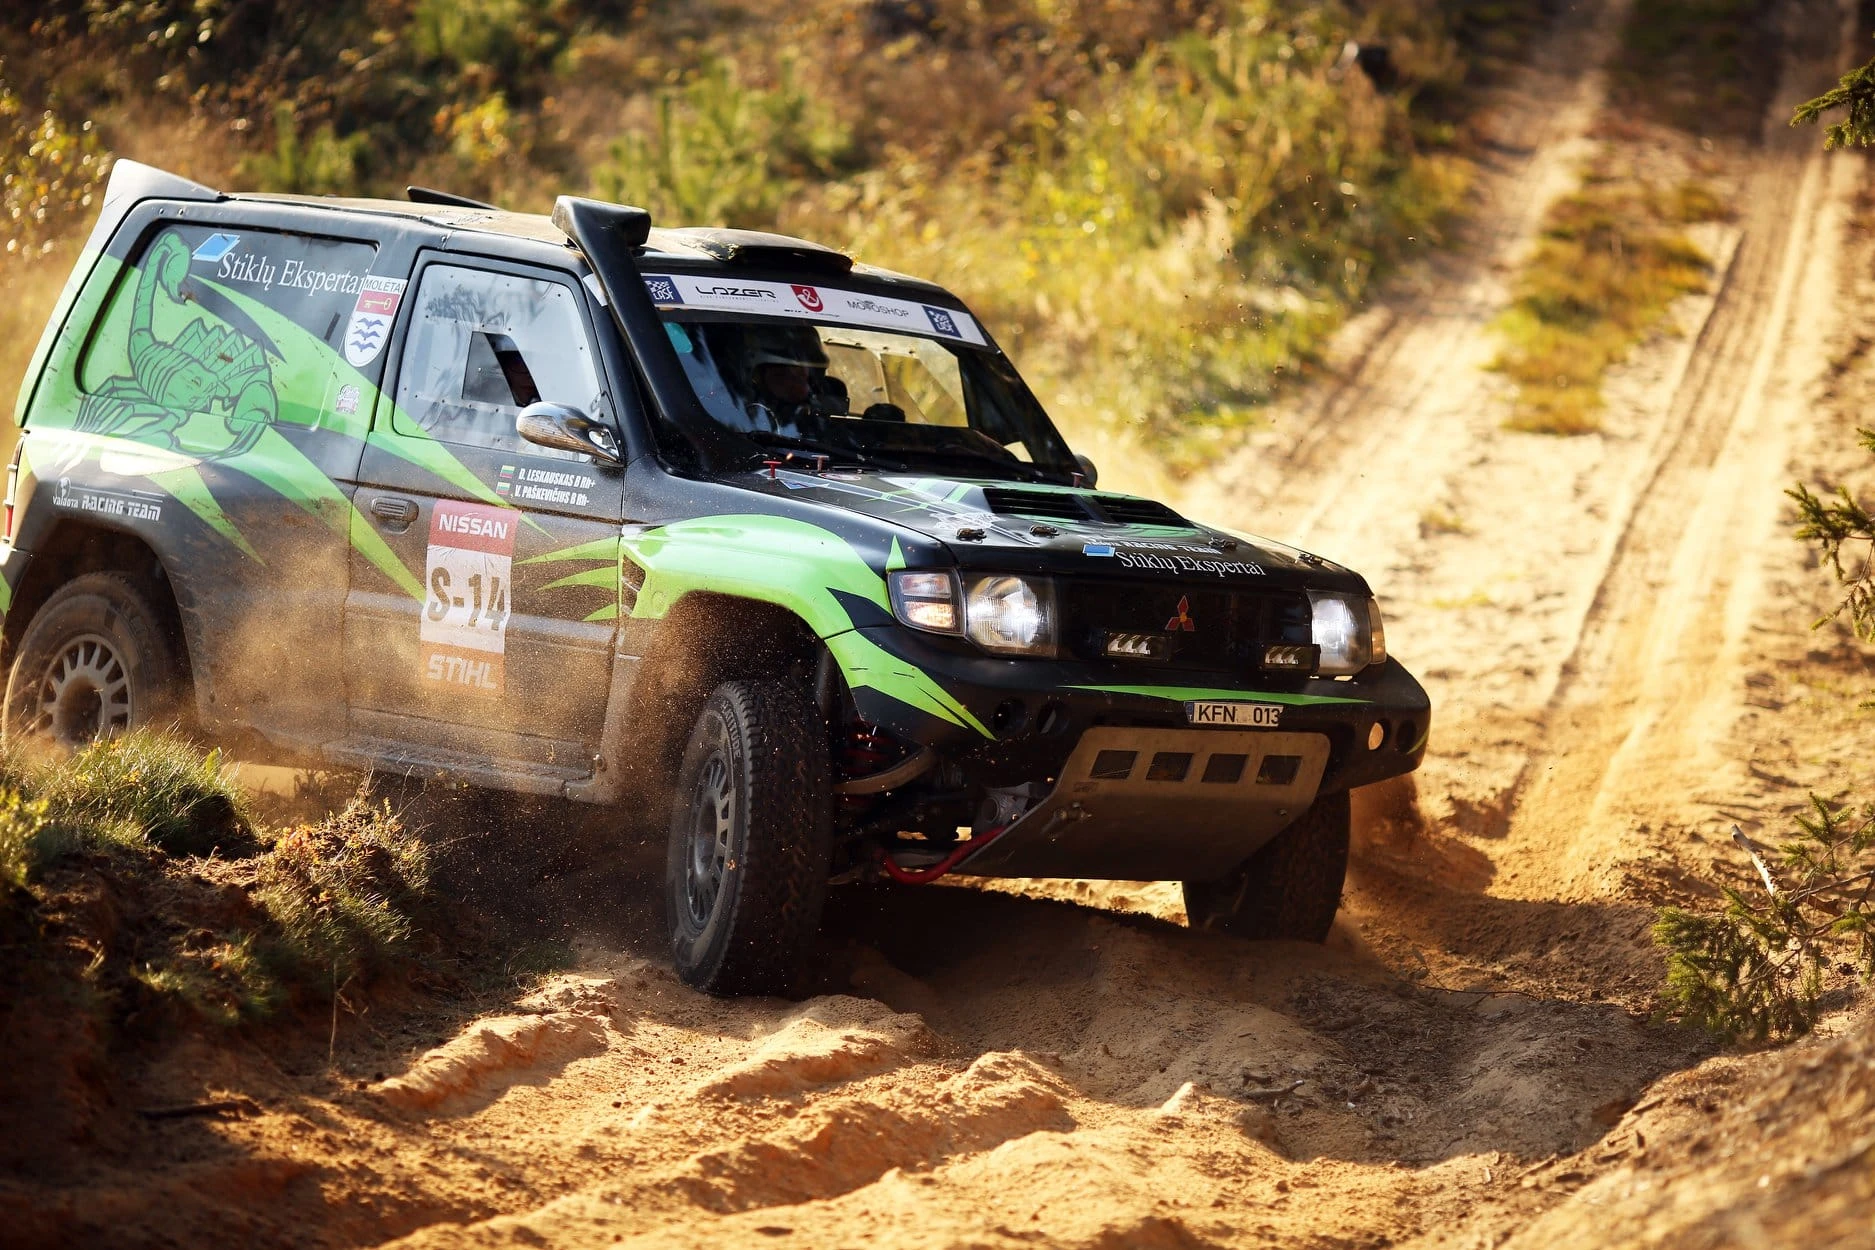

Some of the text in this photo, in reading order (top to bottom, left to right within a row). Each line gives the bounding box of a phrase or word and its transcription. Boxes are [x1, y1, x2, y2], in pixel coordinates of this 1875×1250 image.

[217, 252, 369, 296] Stiklų Ekspertai
[127, 501, 162, 521] TEAM
[439, 513, 508, 540] NISSAN
[1115, 551, 1267, 578] Stiklų Ekspertai
[427, 566, 506, 632] S-14
[427, 652, 498, 690] STIHL
[1198, 704, 1236, 722] KFN
[1253, 707, 1281, 725] 013
